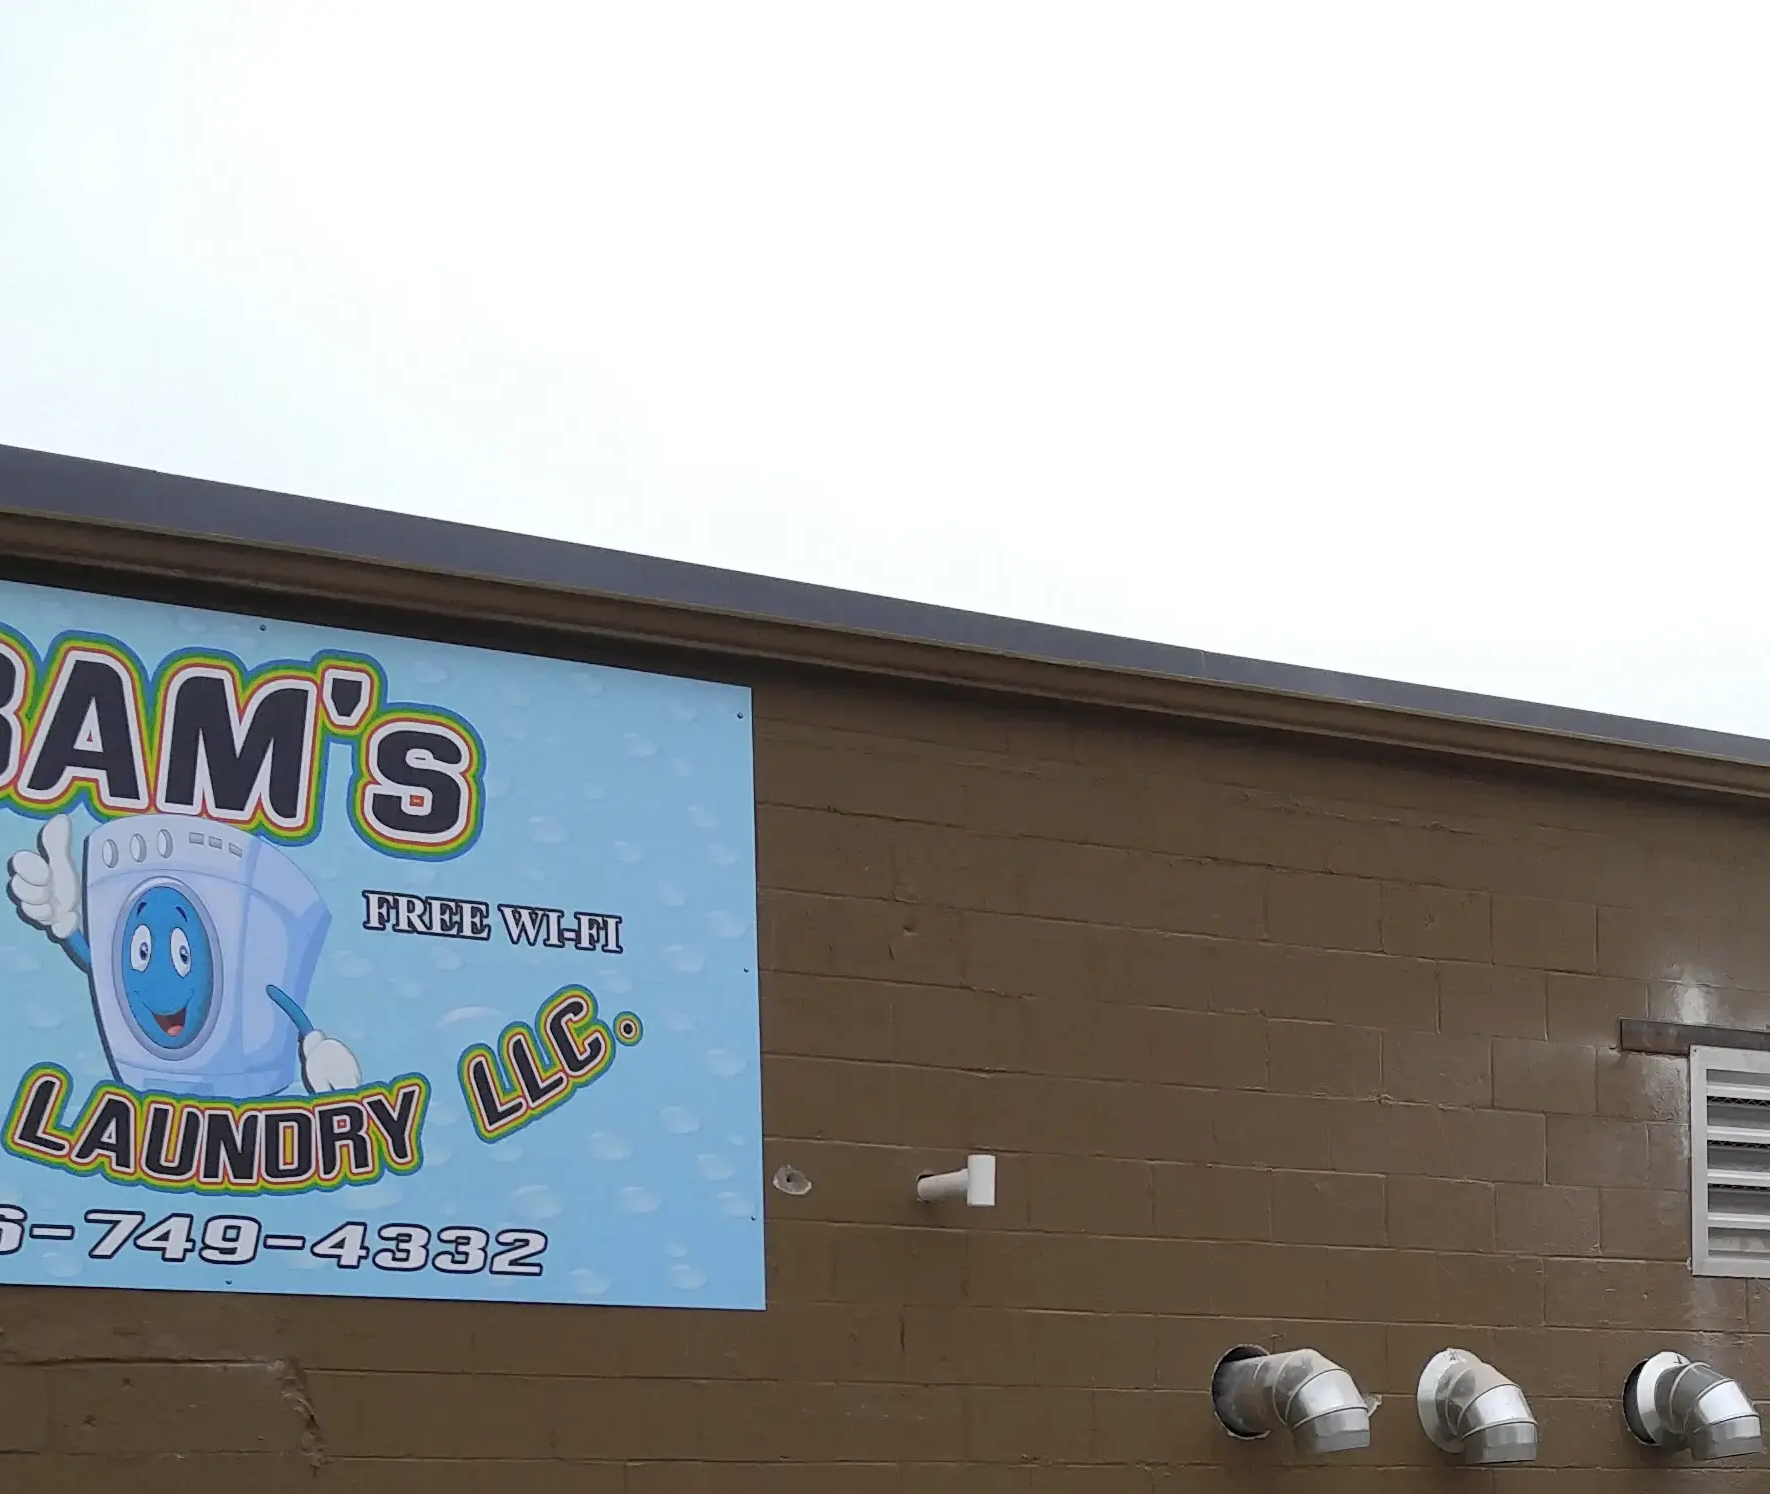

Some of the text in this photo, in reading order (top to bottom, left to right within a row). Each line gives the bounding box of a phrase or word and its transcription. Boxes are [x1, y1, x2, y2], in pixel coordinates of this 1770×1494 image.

[362, 889, 623, 953] FREE WI-FI
[6, 1068, 426, 1190] LAUNDRY
[462, 990, 640, 1138] LLC.
